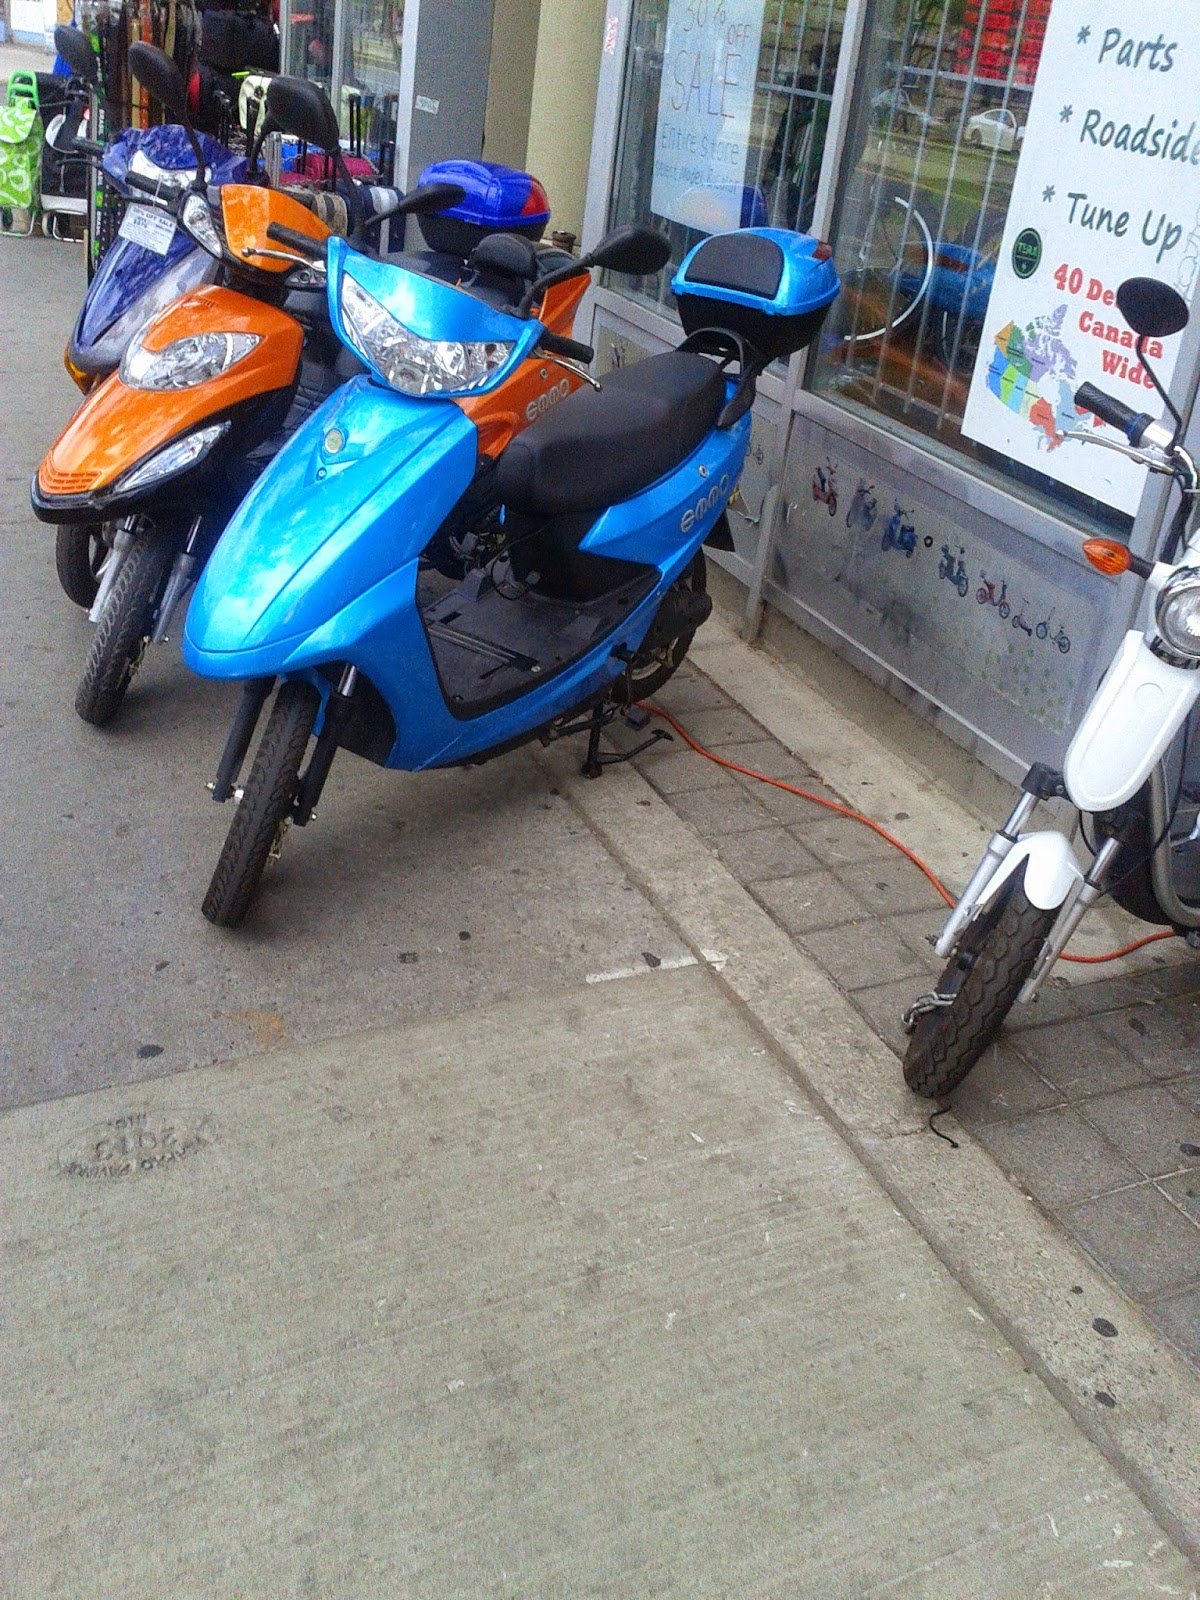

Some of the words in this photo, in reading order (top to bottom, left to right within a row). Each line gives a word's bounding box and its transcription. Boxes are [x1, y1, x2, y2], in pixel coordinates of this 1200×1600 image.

[727, 24, 751, 48] OFF
[1098, 27, 1178, 72] Parts
[671, 49, 742, 119] SALE
[1080, 108, 1200, 166] Roadside
[1067, 191, 1130, 238] Tune
[1141, 209, 1183, 265] Up
[1054, 263, 1083, 294] 40
[1078, 310, 1164, 359] Canada
[1102, 349, 1155, 389] Wide
